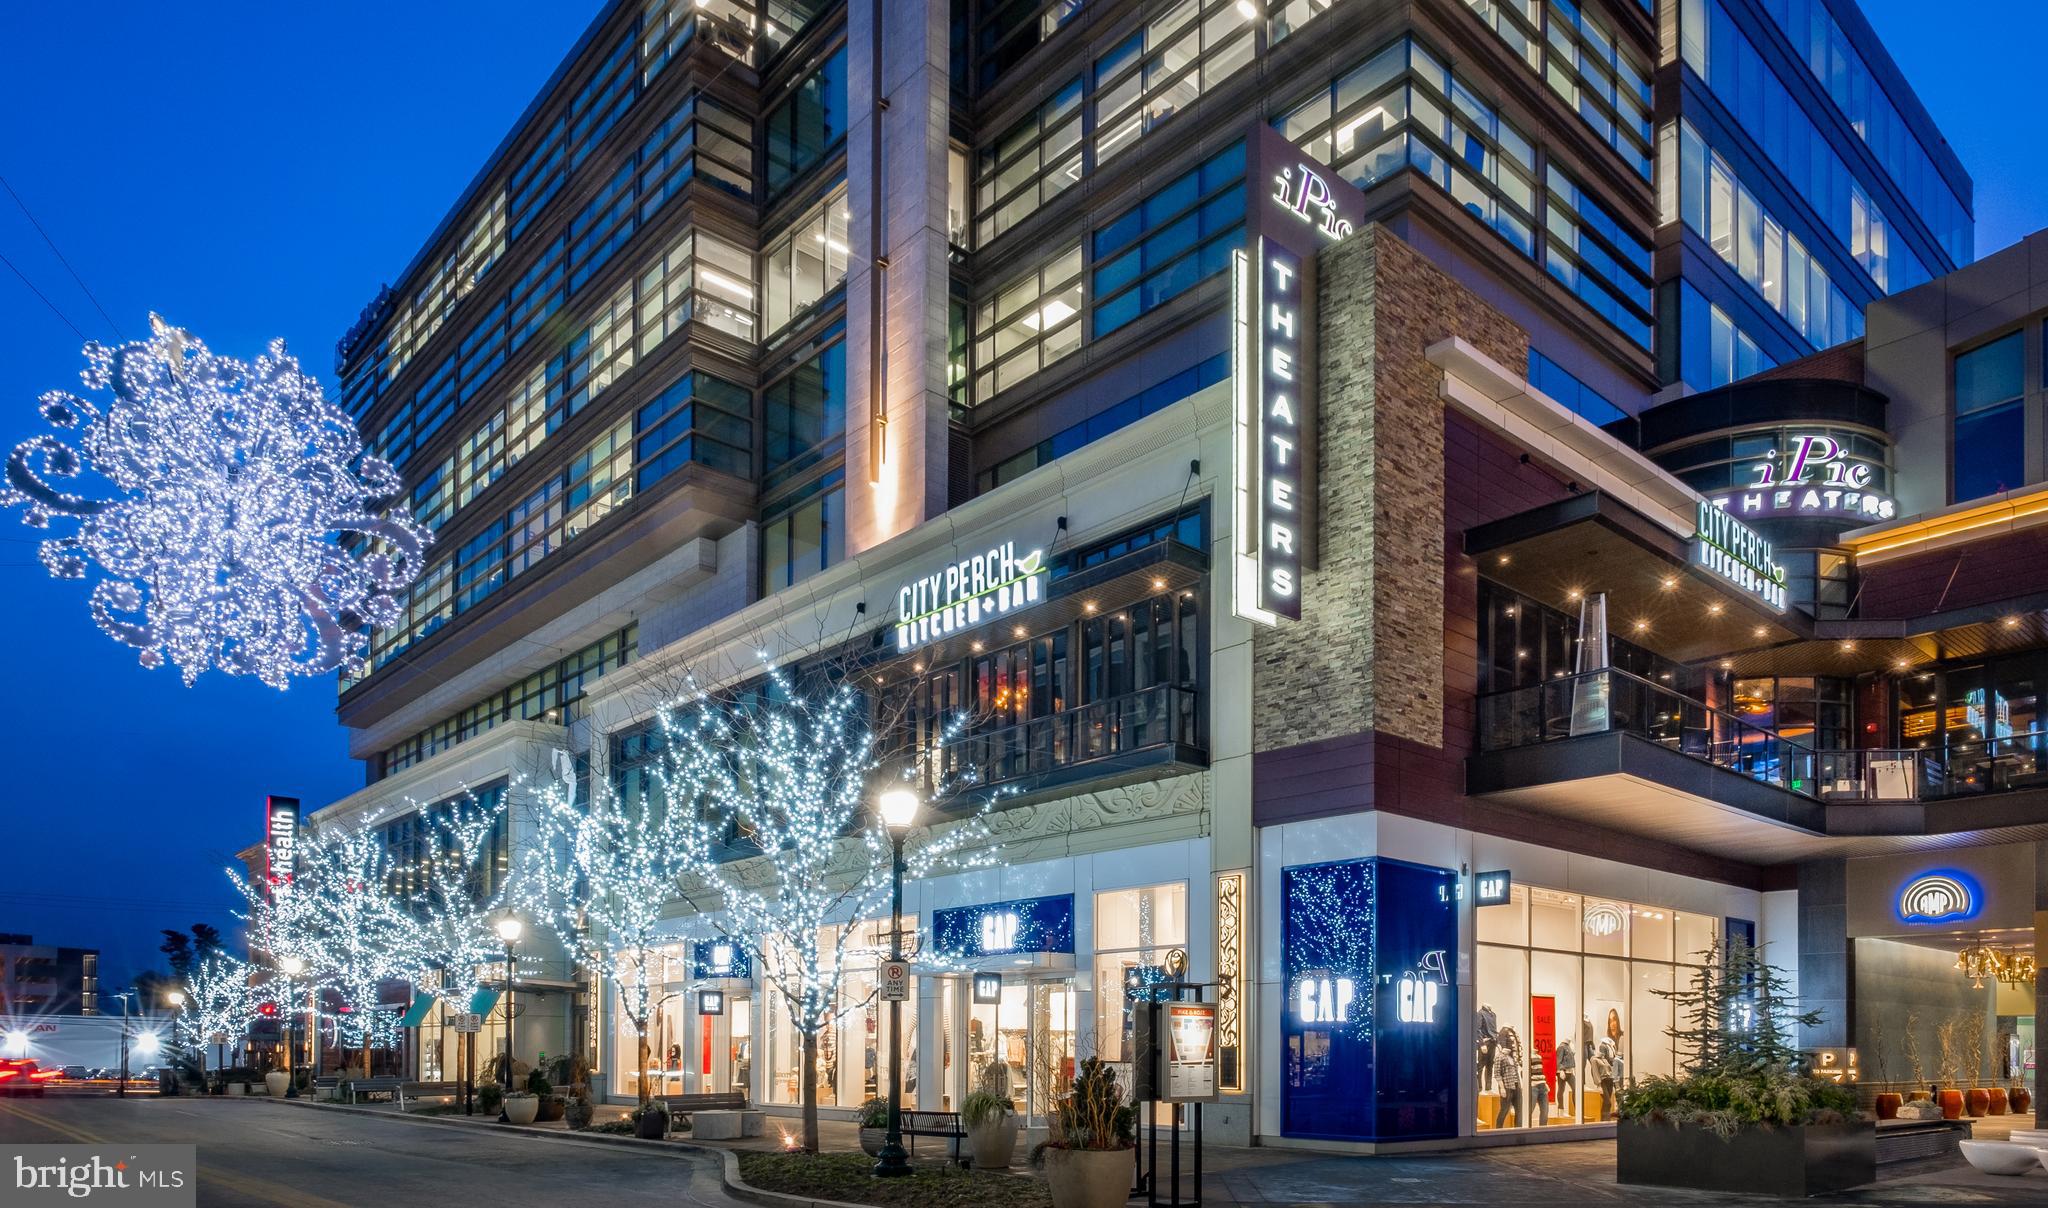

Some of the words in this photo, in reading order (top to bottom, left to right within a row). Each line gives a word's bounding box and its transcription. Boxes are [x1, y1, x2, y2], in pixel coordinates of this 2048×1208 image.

[1271, 257, 1294, 598] THEATERS
[1749, 434, 1872, 490] iPic
[1712, 489, 1895, 520] THEATERS
[1700, 499, 1730, 550] CITY
[1731, 518, 1772, 577] PERCH
[899, 572, 943, 623] CITY
[946, 541, 1015, 605] PERCH
[270, 810, 294, 873] health
[1480, 880, 1503, 898] GAP
[1920, 891, 1949, 915] AMP
[982, 913, 1018, 950] GAP
[979, 981, 998, 998] GAP
[1300, 978, 1353, 1023] GAP
[1399, 979, 1438, 1022] GAP
[1822, 1053, 1835, 1066] P
